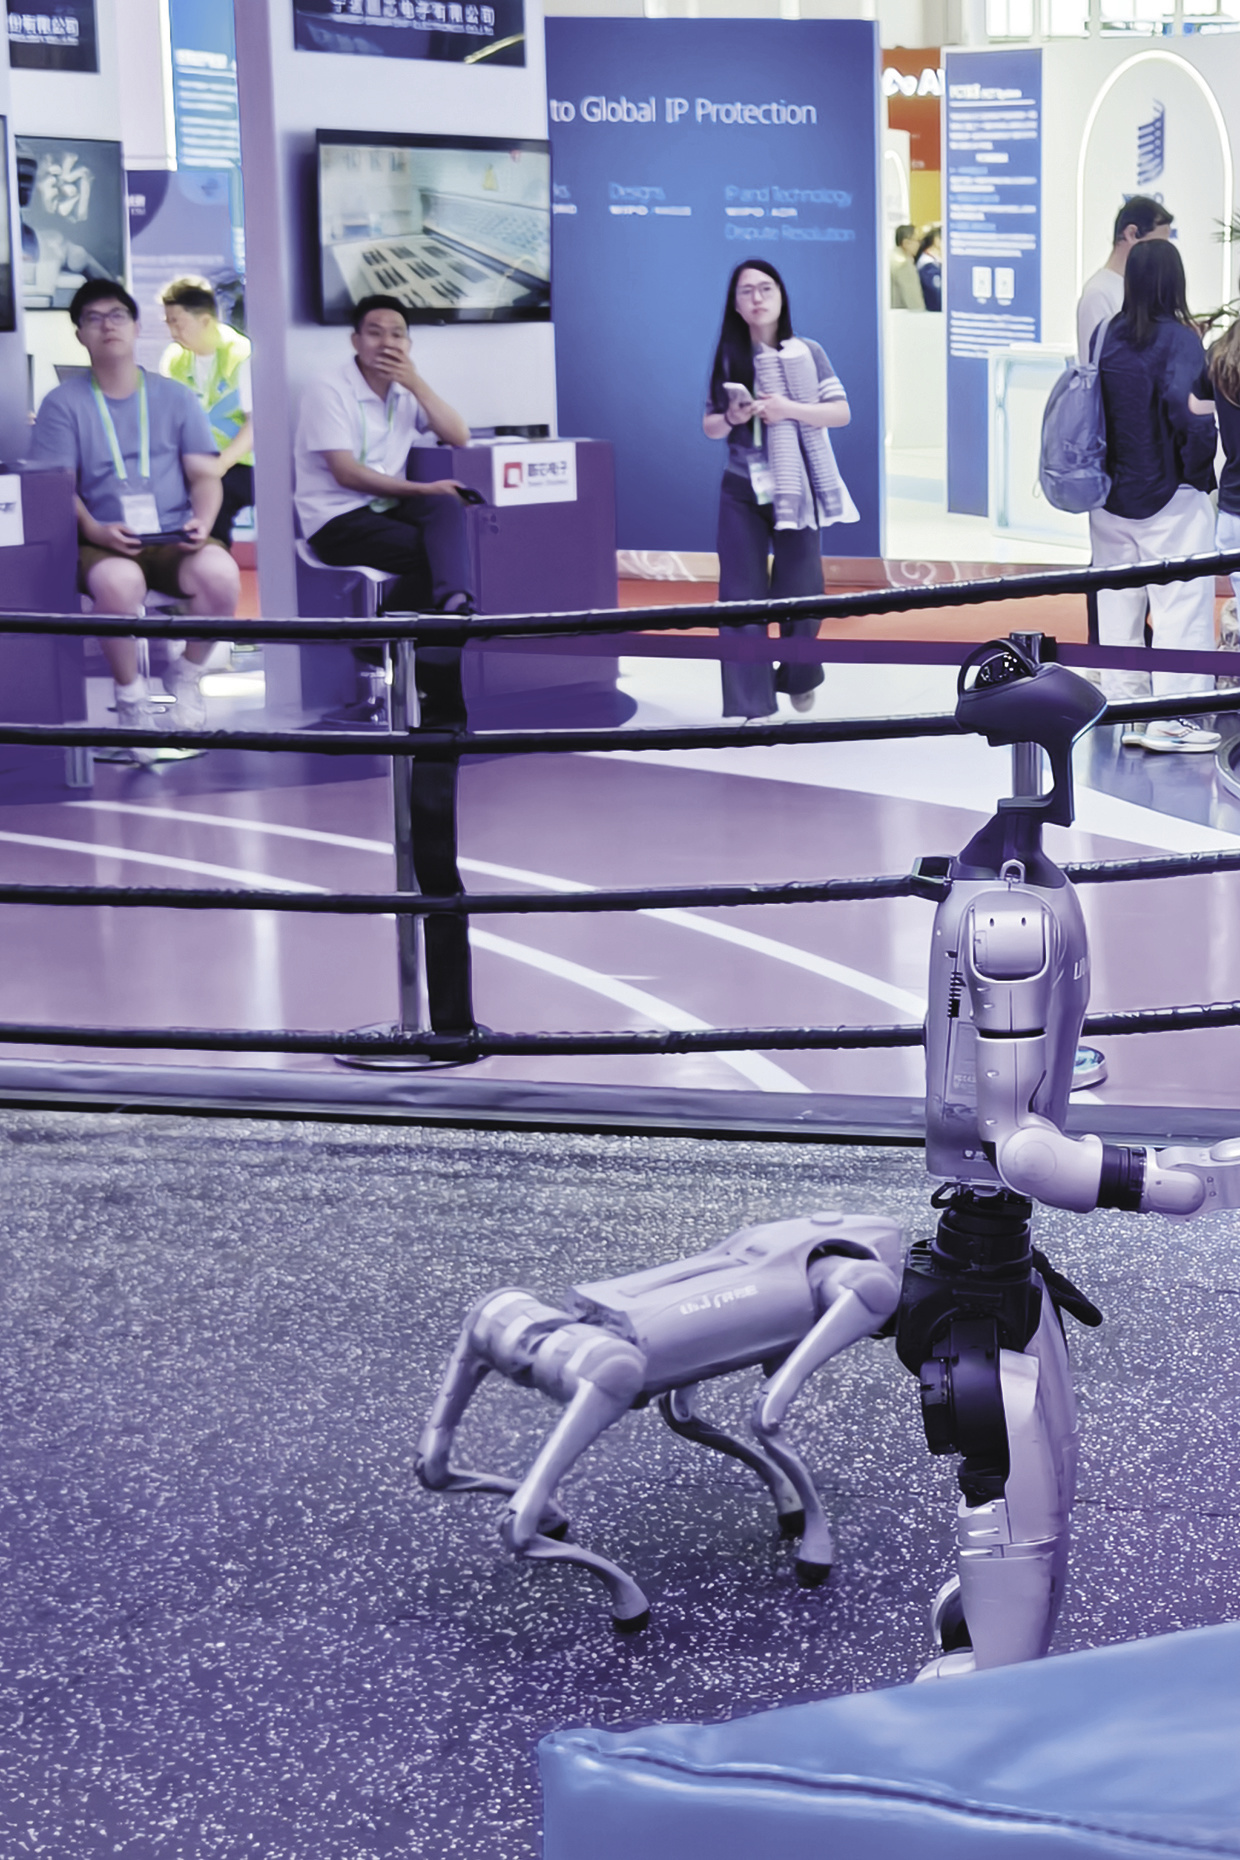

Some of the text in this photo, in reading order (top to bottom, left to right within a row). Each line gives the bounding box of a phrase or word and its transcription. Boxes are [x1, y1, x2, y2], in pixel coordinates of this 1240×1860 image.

[550, 96, 817, 125] to Global IP Protection
